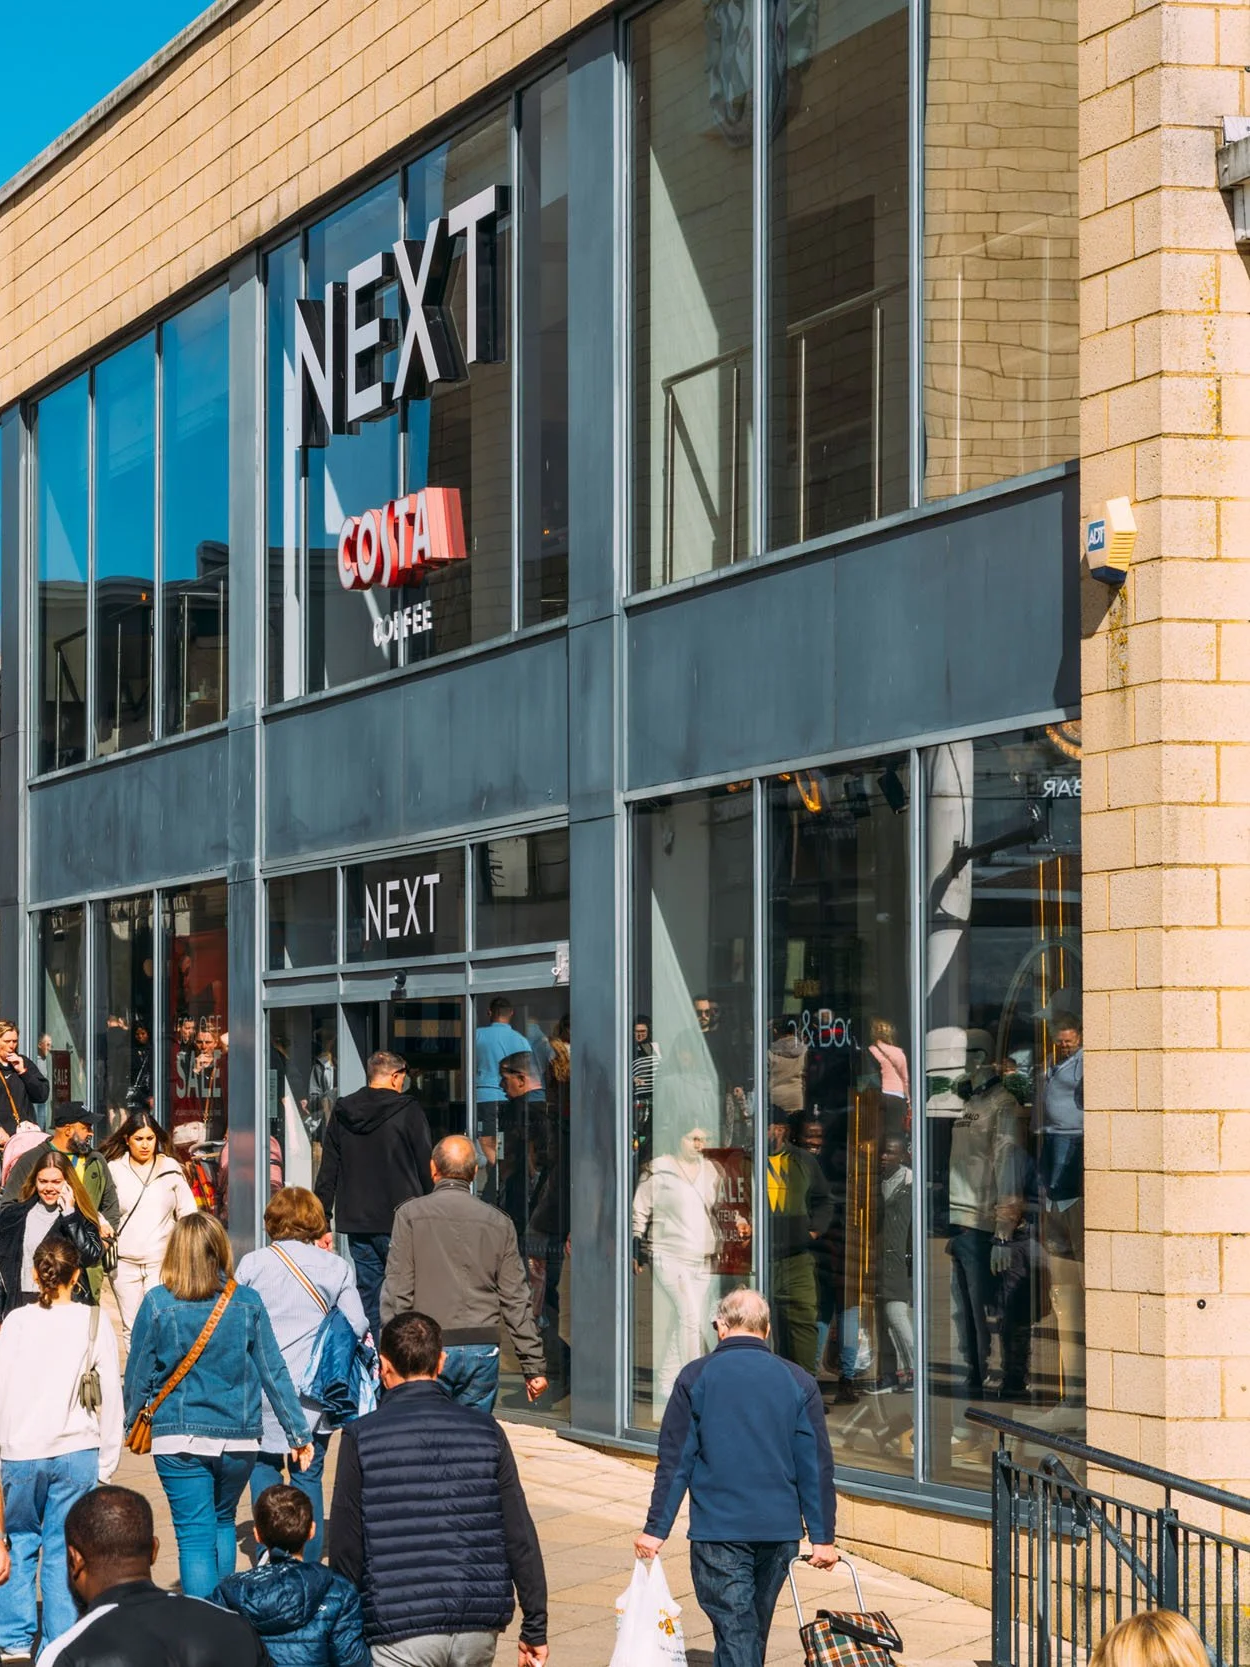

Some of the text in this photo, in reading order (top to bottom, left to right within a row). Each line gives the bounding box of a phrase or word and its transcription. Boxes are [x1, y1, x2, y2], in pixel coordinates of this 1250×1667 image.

[295, 184, 508, 446] NEXT
[338, 489, 442, 590] COSTA
[1088, 526, 1105, 547] ADT
[373, 600, 433, 647] COFFEE
[365, 873, 440, 941] NEXT
[717, 1177, 745, 1203] ALE
